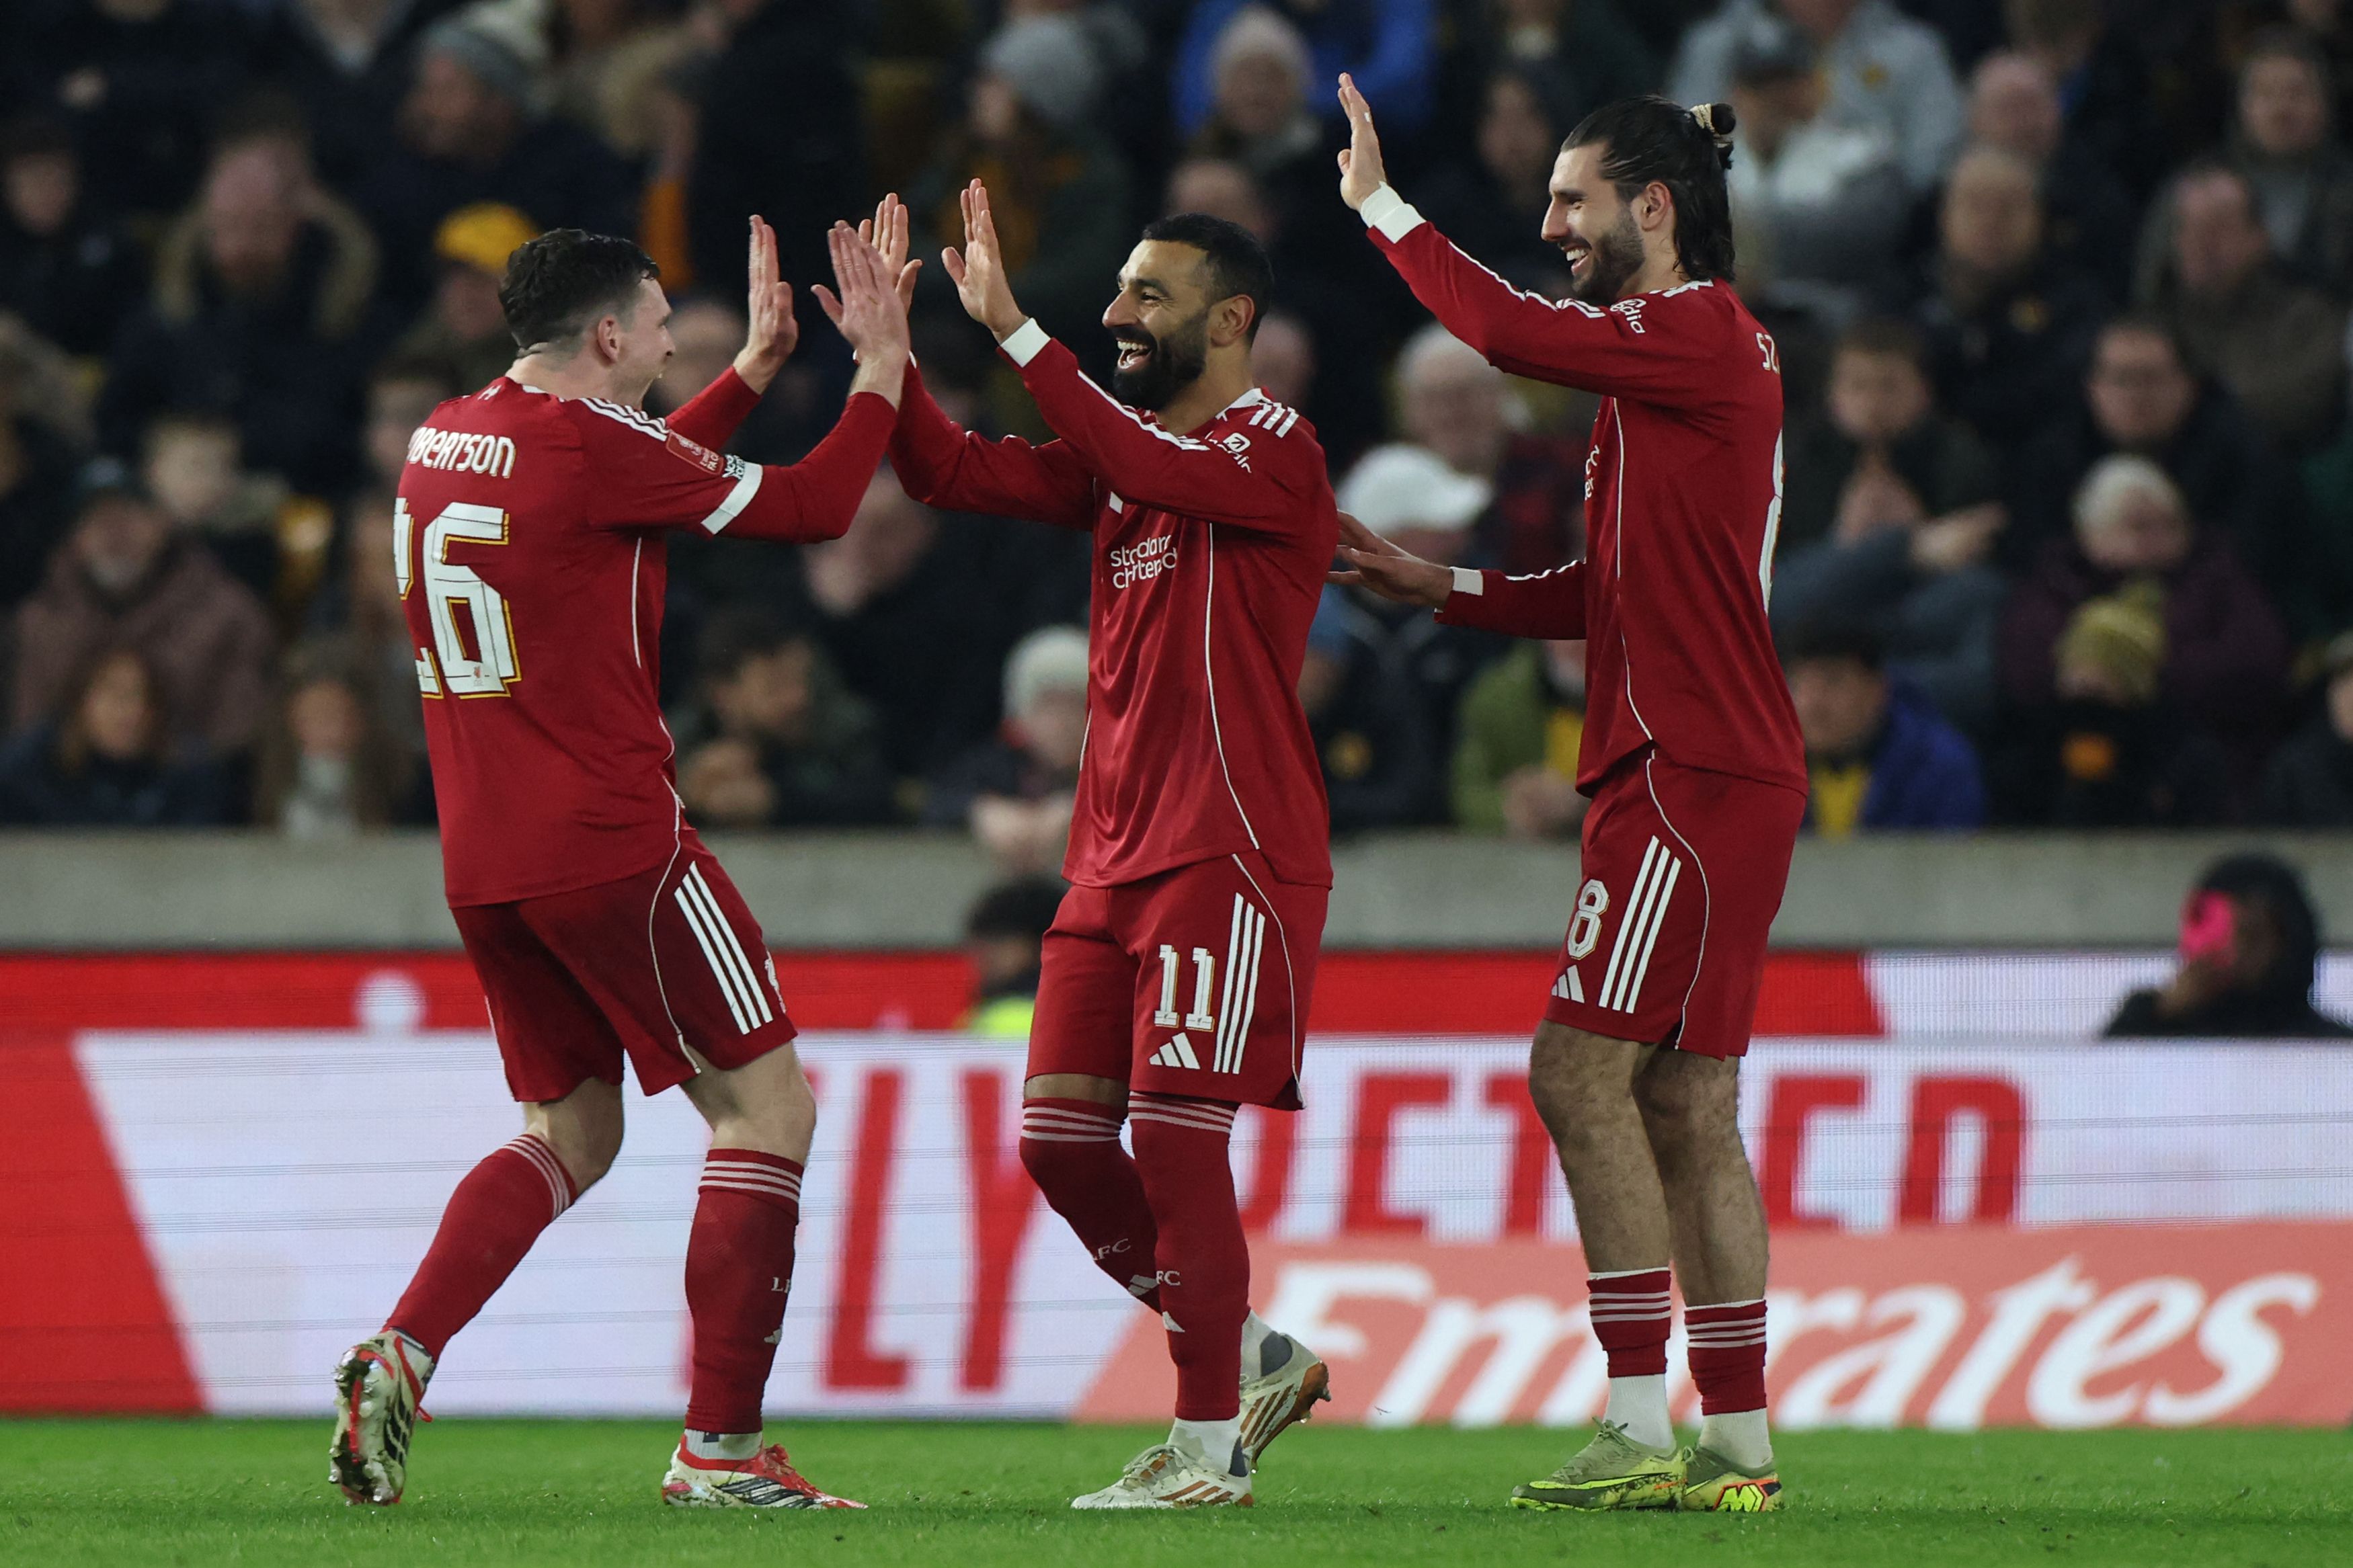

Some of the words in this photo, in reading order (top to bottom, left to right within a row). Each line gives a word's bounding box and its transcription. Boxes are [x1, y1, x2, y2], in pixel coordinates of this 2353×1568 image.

[407, 426, 516, 479] OBERTSON
[1568, 878, 1610, 960] 8
[1154, 944, 1215, 1032] 11
[686, 1069, 1042, 1390] LY
[1156, 1270, 1181, 1286] FC
